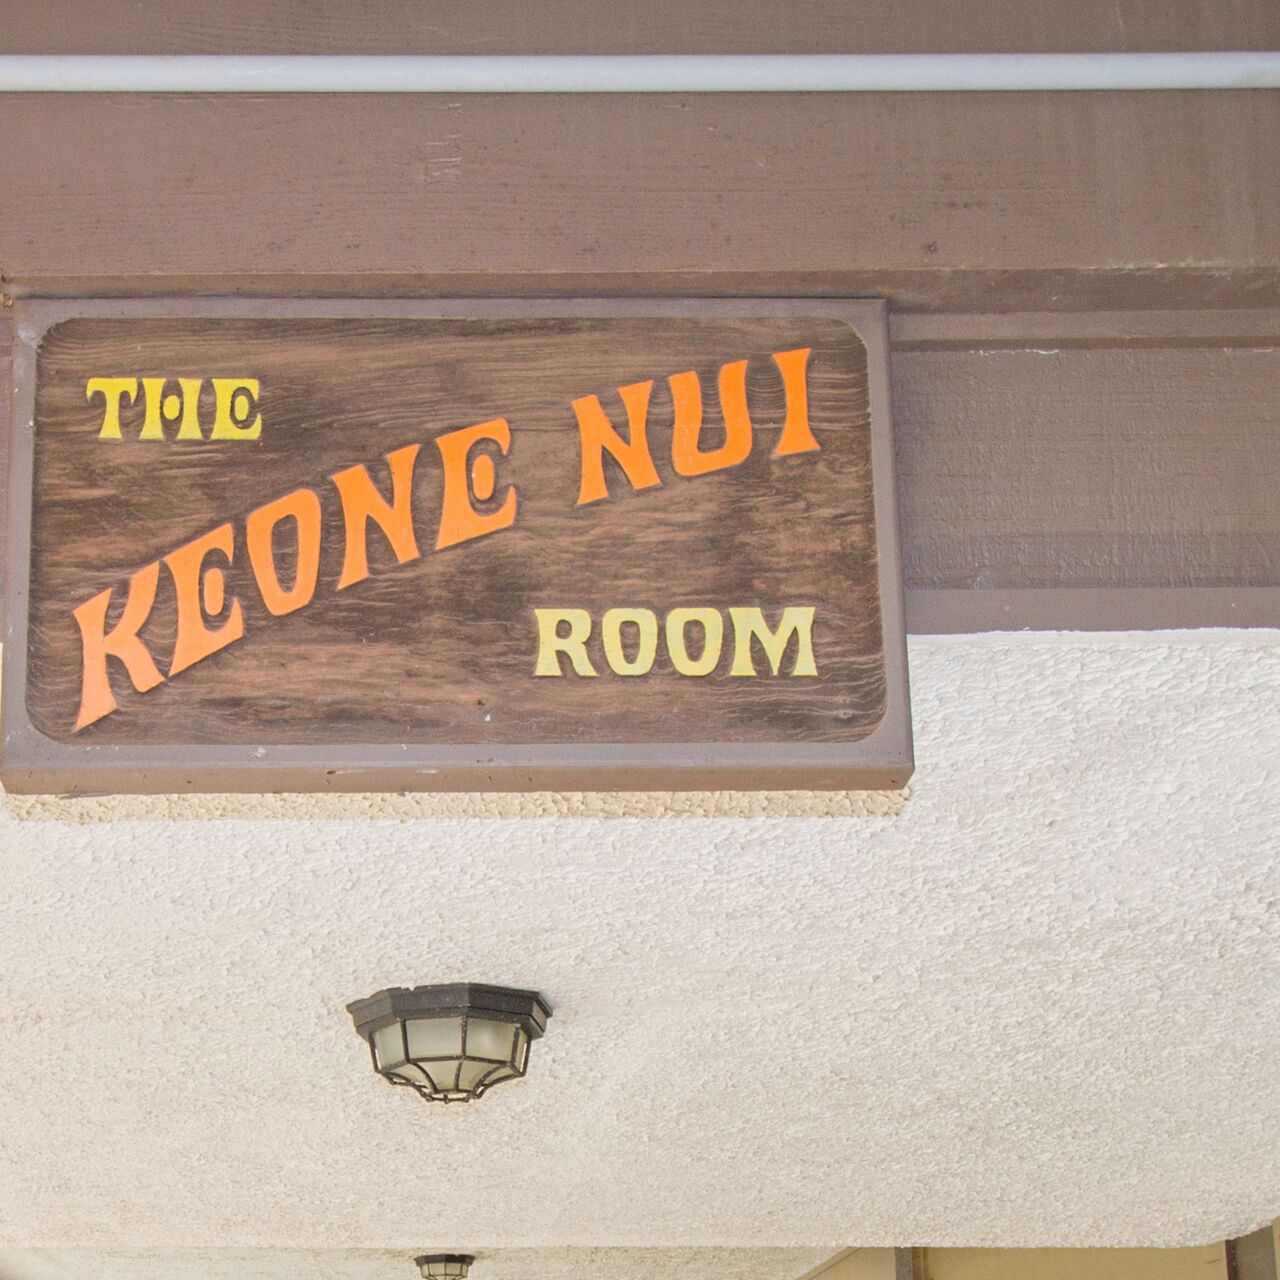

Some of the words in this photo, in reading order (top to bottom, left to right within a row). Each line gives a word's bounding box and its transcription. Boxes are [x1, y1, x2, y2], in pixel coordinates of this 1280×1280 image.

[86, 377, 262, 441] THE
[72, 416, 517, 731] KEONE
[572, 347, 822, 506] NUI
[534, 606, 818, 677] ROOM
